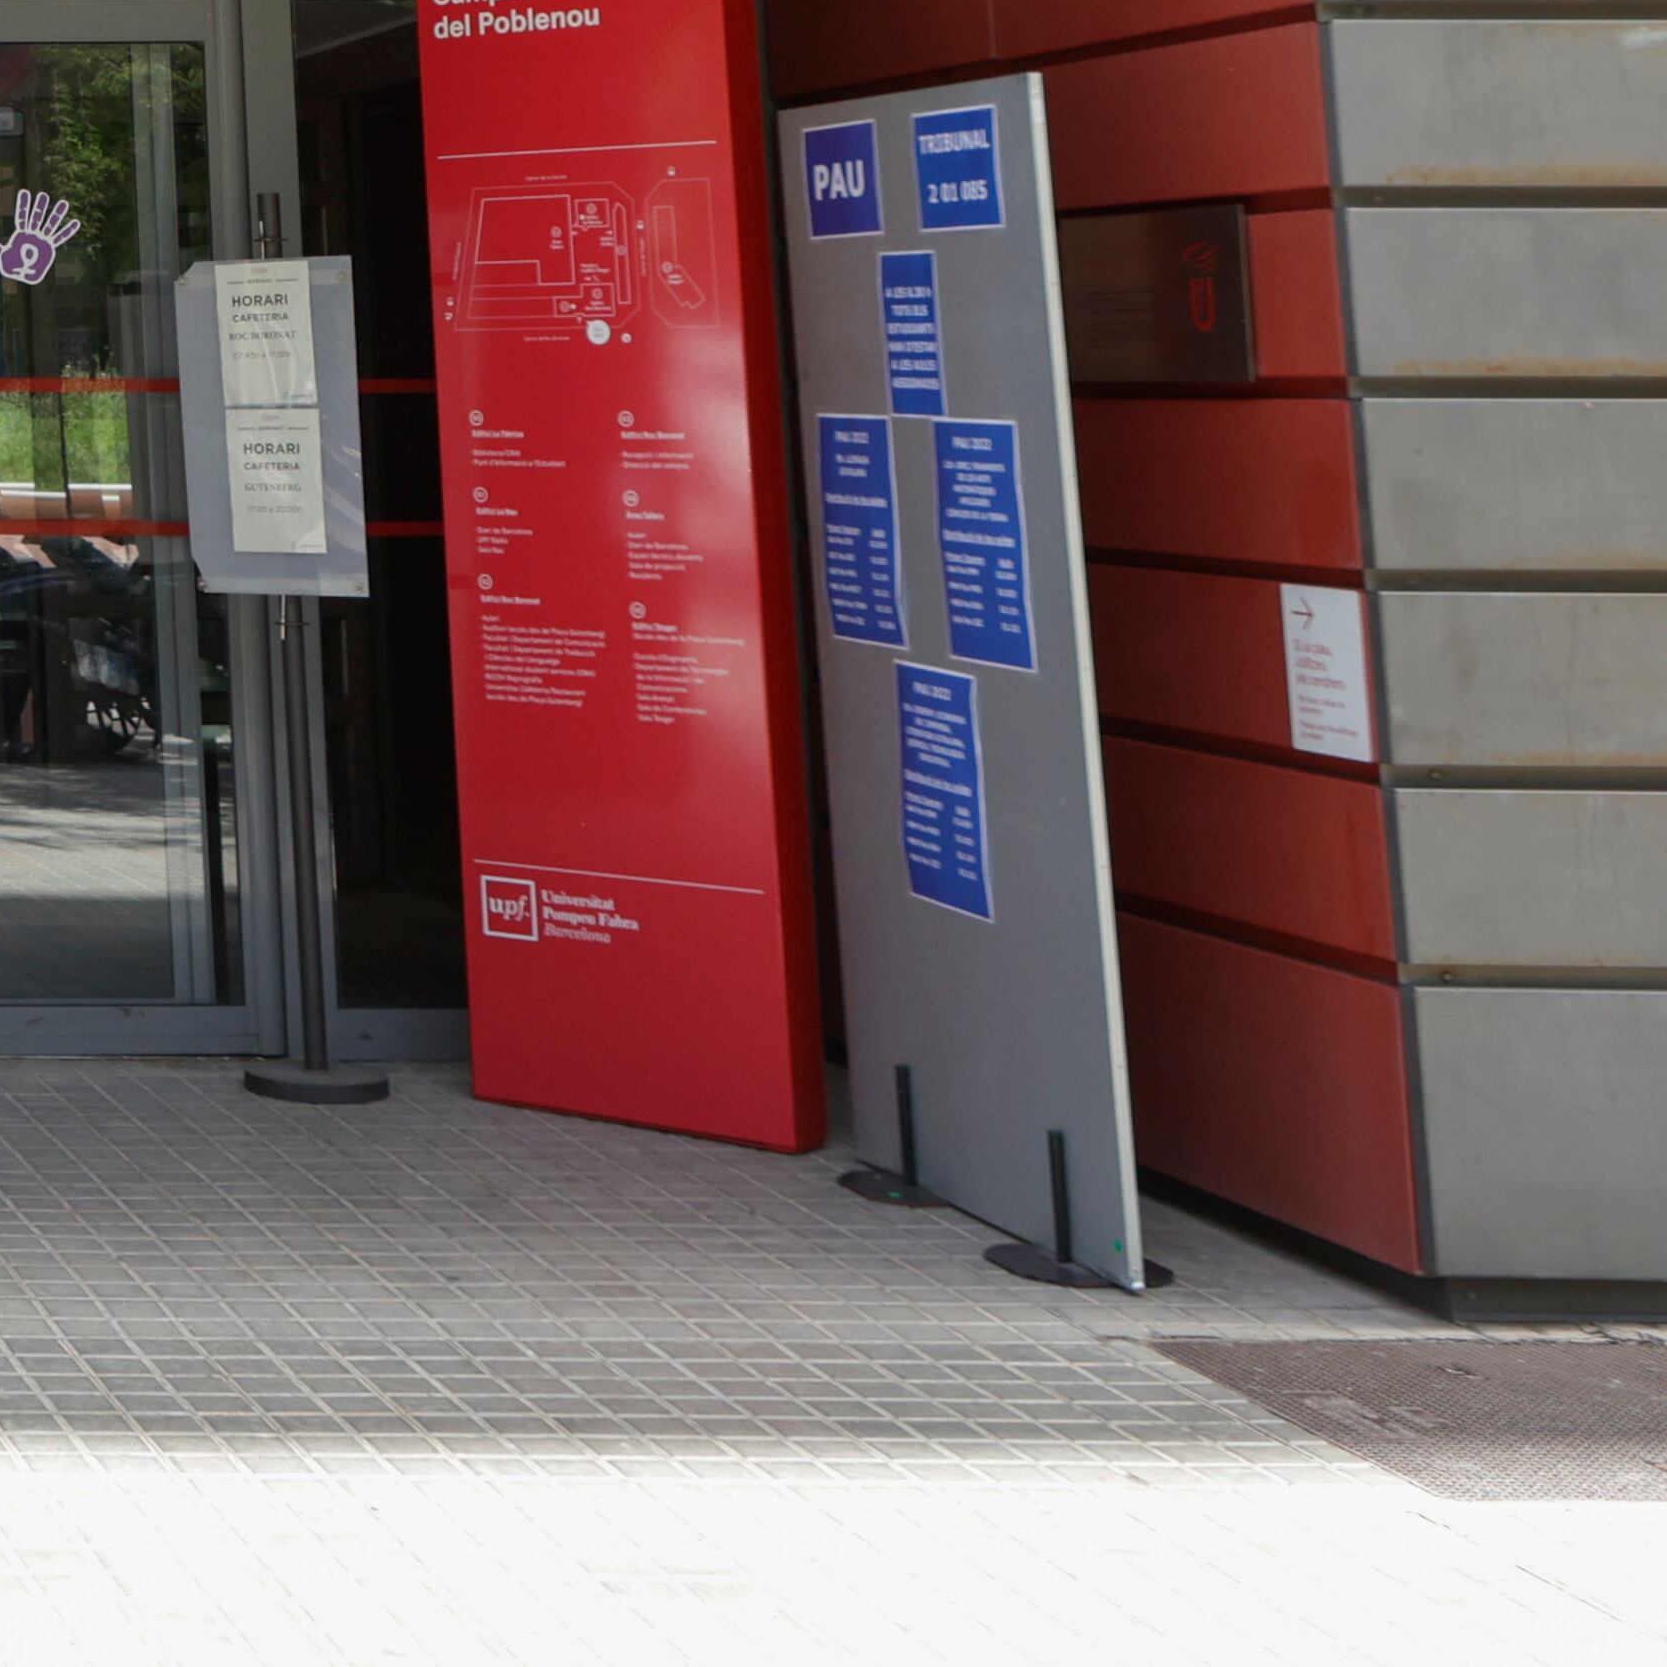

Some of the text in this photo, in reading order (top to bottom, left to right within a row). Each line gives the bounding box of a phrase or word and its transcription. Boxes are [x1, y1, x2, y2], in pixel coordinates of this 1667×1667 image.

[433, 8, 600, 39] del Poblenou
[918, 129, 991, 155] TRIBUNAL
[813, 159, 866, 201] PAU
[928, 184, 940, 203] 2
[231, 294, 289, 307] HORARI
[232, 312, 290, 323] CAFETERIA
[243, 443, 300, 455] HORARI
[244, 460, 301, 471] CAFETERIA
[541, 889, 615, 911] Universitat
[543, 907, 639, 931] Pompeu Fabra
[544, 924, 611, 943] Barcelona
